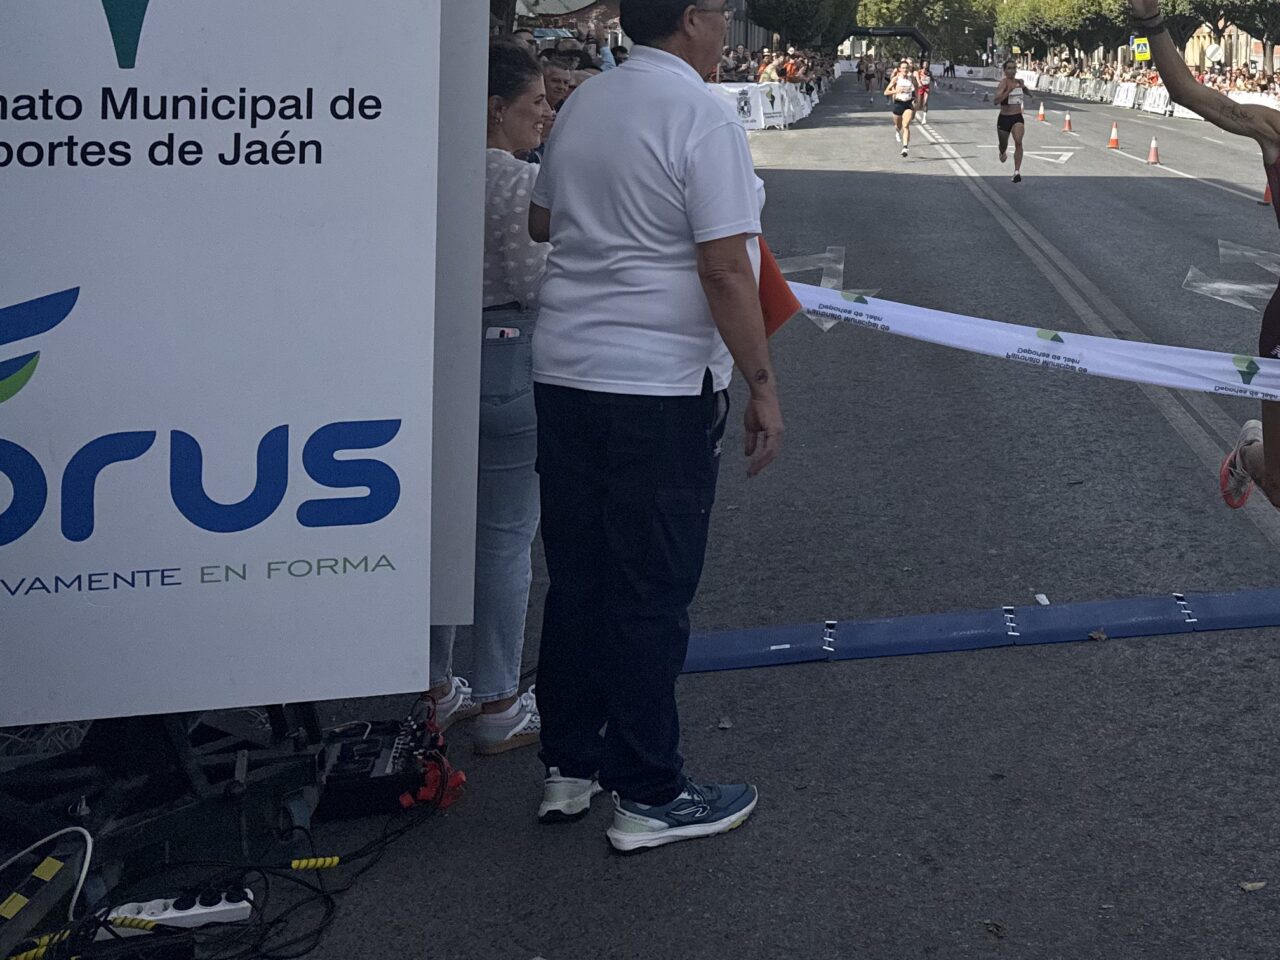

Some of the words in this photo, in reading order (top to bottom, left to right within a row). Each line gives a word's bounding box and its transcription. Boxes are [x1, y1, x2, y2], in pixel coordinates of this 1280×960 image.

[101, 87, 314, 128] Municipal
[329, 88, 382, 120] de
[148, 134, 204, 167] de
[218, 130, 323, 166] Jaén
[200, 564, 247, 584] EN
[266, 554, 396, 579] FORMA
